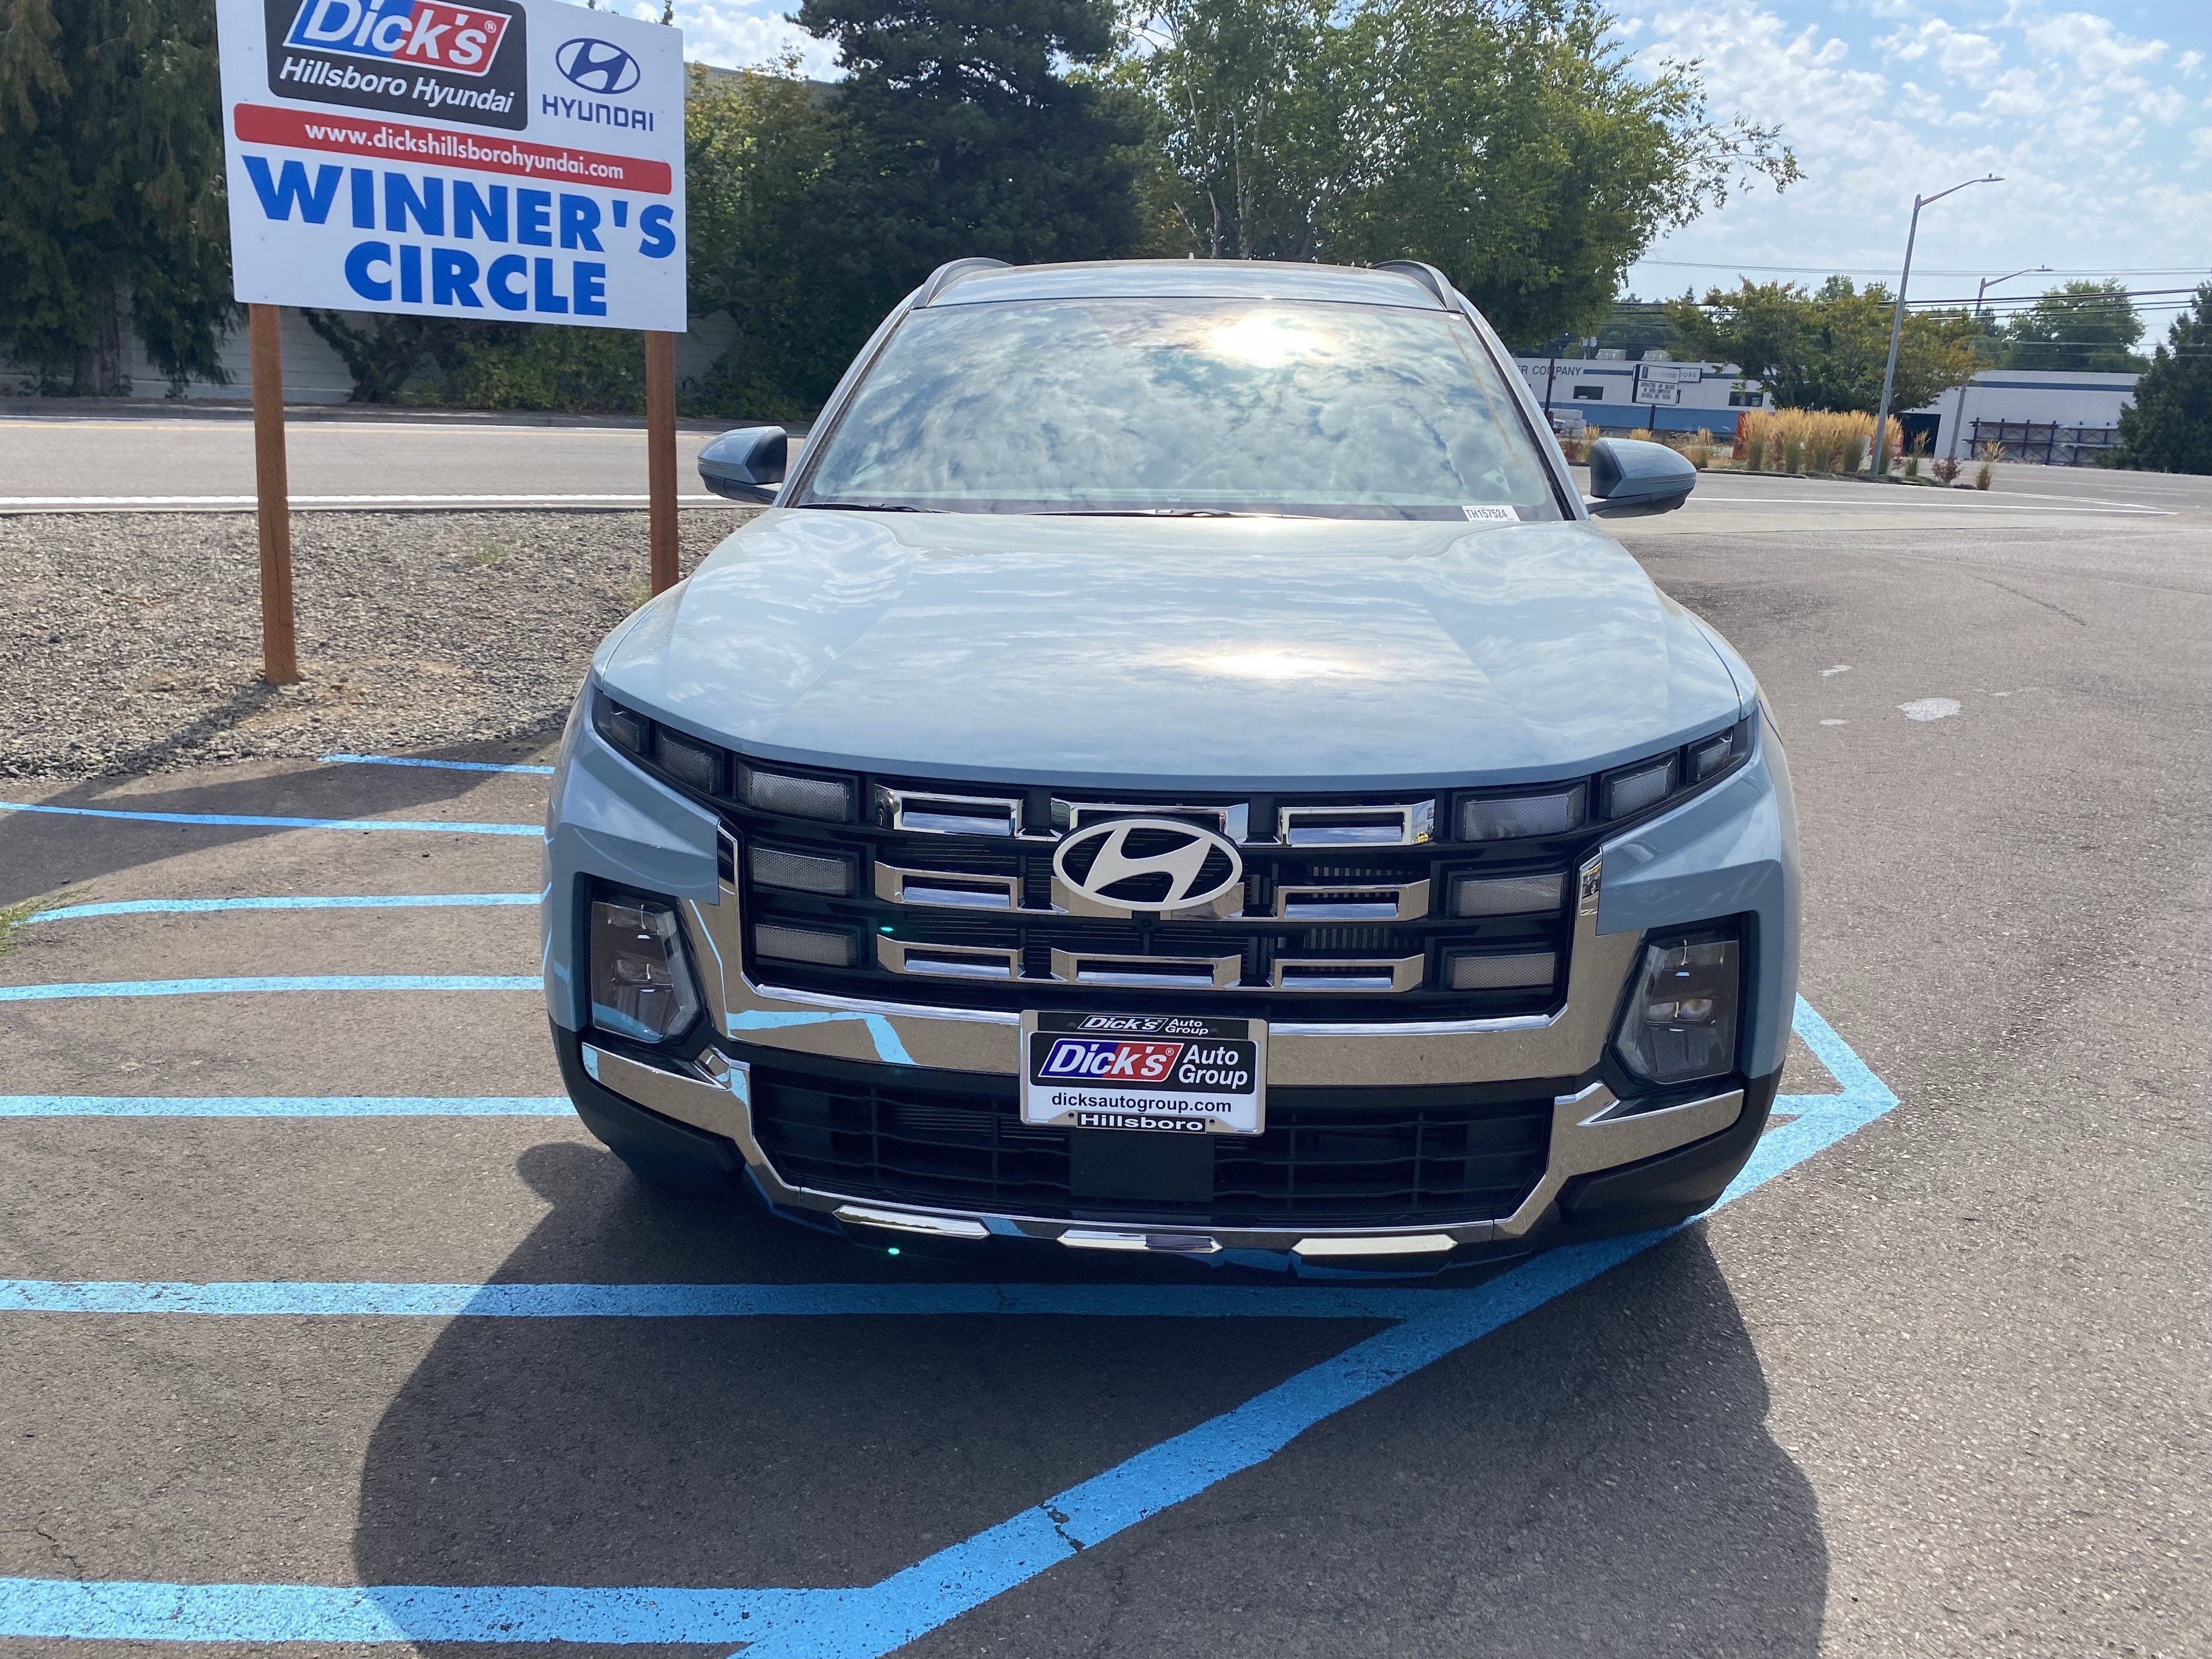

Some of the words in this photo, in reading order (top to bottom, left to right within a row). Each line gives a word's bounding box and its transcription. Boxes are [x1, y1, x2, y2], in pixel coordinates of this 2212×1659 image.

[303, 0, 487, 65] Dick's
[279, 56, 407, 96] Hillsboro
[411, 76, 515, 113] Hyundai
[542, 94, 654, 132] HYUNDAI
[304, 123, 624, 180] www.dickshillsborohyundai.com
[241, 155, 676, 258] WINNER'S
[345, 241, 607, 317] CIRCLE
[1532, 365, 1582, 376] COPANY
[1465, 509, 1508, 518] TH157524
[1085, 1017, 1159, 1031] Dick's
[1169, 1019, 1203, 1028] Auto
[1165, 1025, 1209, 1036] Group
[1048, 1043, 1167, 1077] Dick's
[1182, 1045, 1239, 1066] Auto
[1178, 1063, 1248, 1090] Group
[1051, 1092, 1232, 1114] dicksautogroup.com
[1080, 1114, 1203, 1132] Hillsboro
